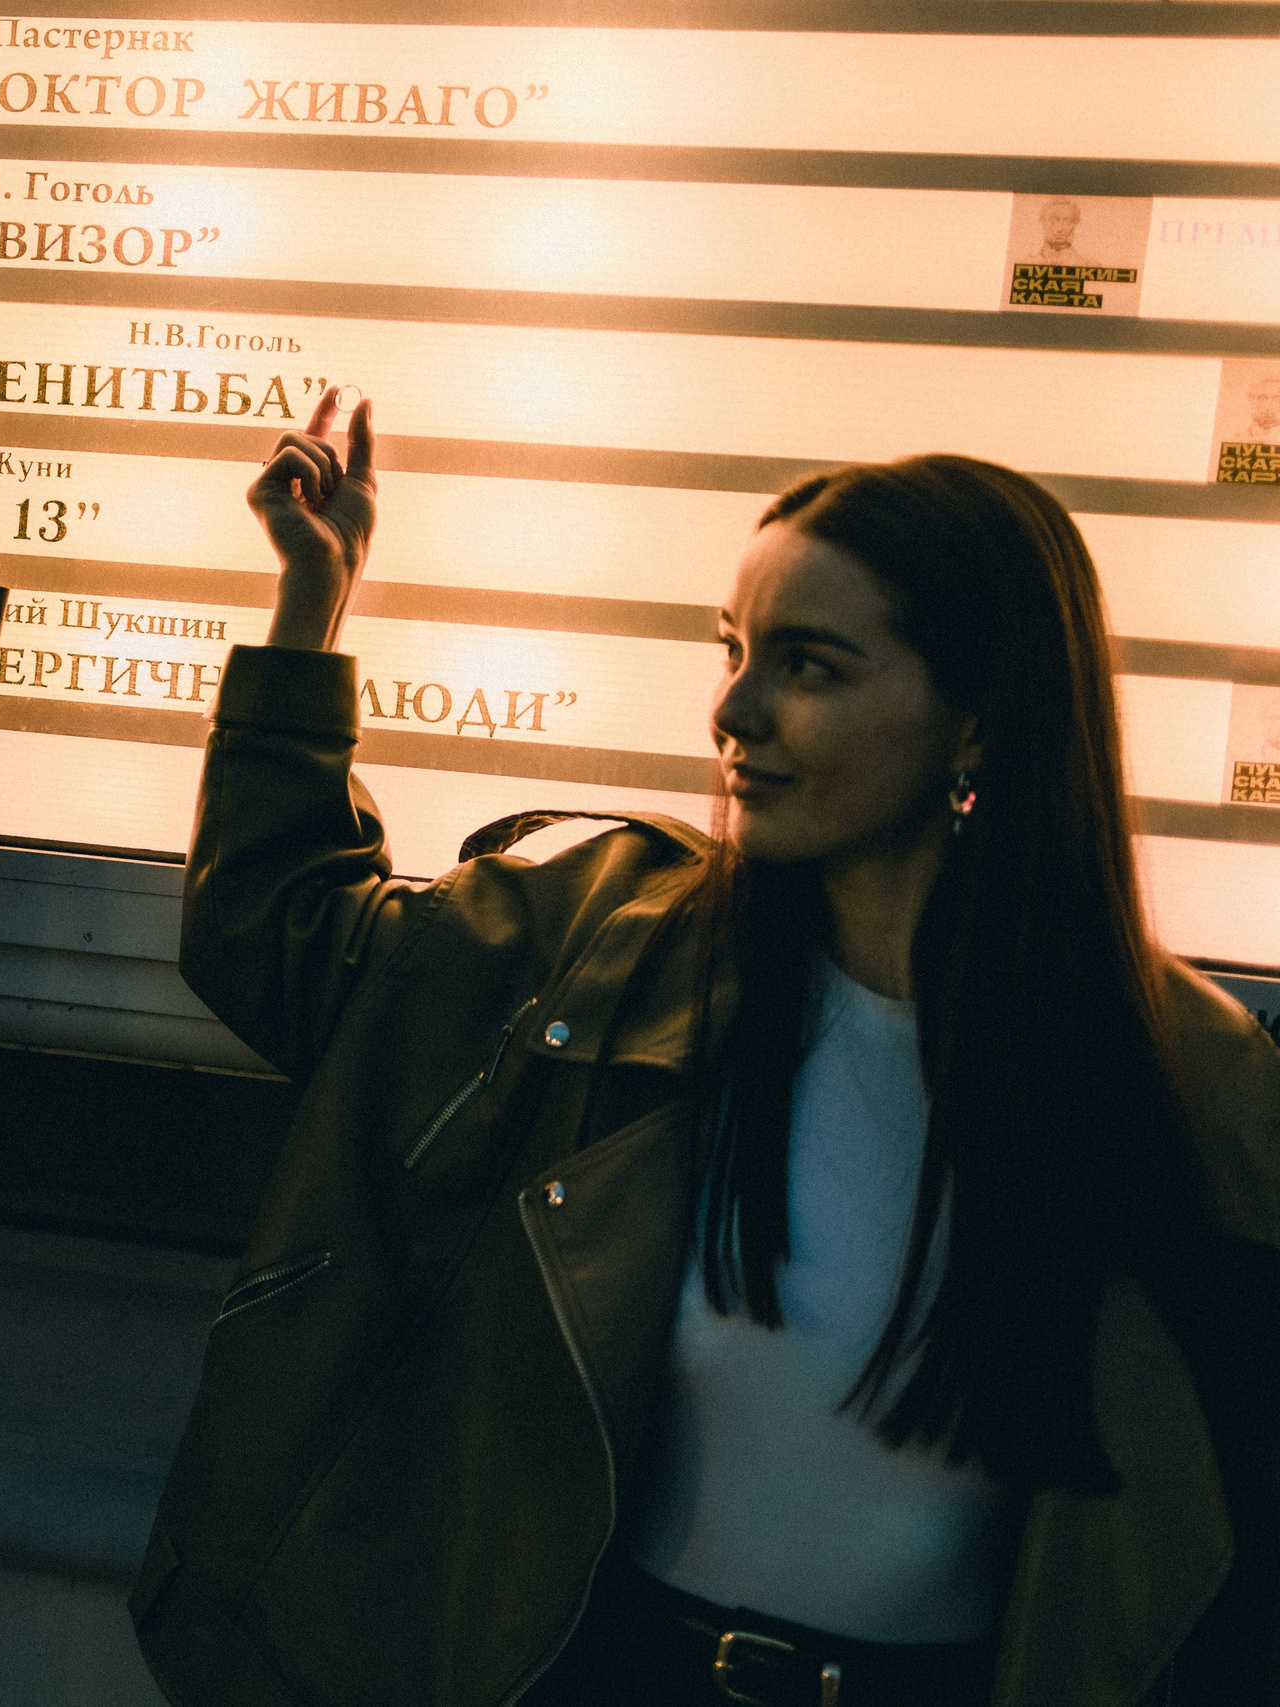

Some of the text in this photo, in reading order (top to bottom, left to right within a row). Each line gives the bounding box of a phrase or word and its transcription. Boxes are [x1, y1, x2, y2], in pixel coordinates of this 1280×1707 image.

[237, 79, 550, 129] ЖИВАГО”
[25, 171, 155, 206] Гоголь
[1160, 220, 1280, 246] ПРЕМ
[1013, 278, 1081, 292] СКАЯ
[1015, 264, 1137, 282] ПУШКИН
[1011, 292, 1100, 307] КАРТА
[128, 321, 302, 354] Н.В.Гоголь
[13, 498, 101, 542] 13”
[58, 599, 228, 640] Шукшин
